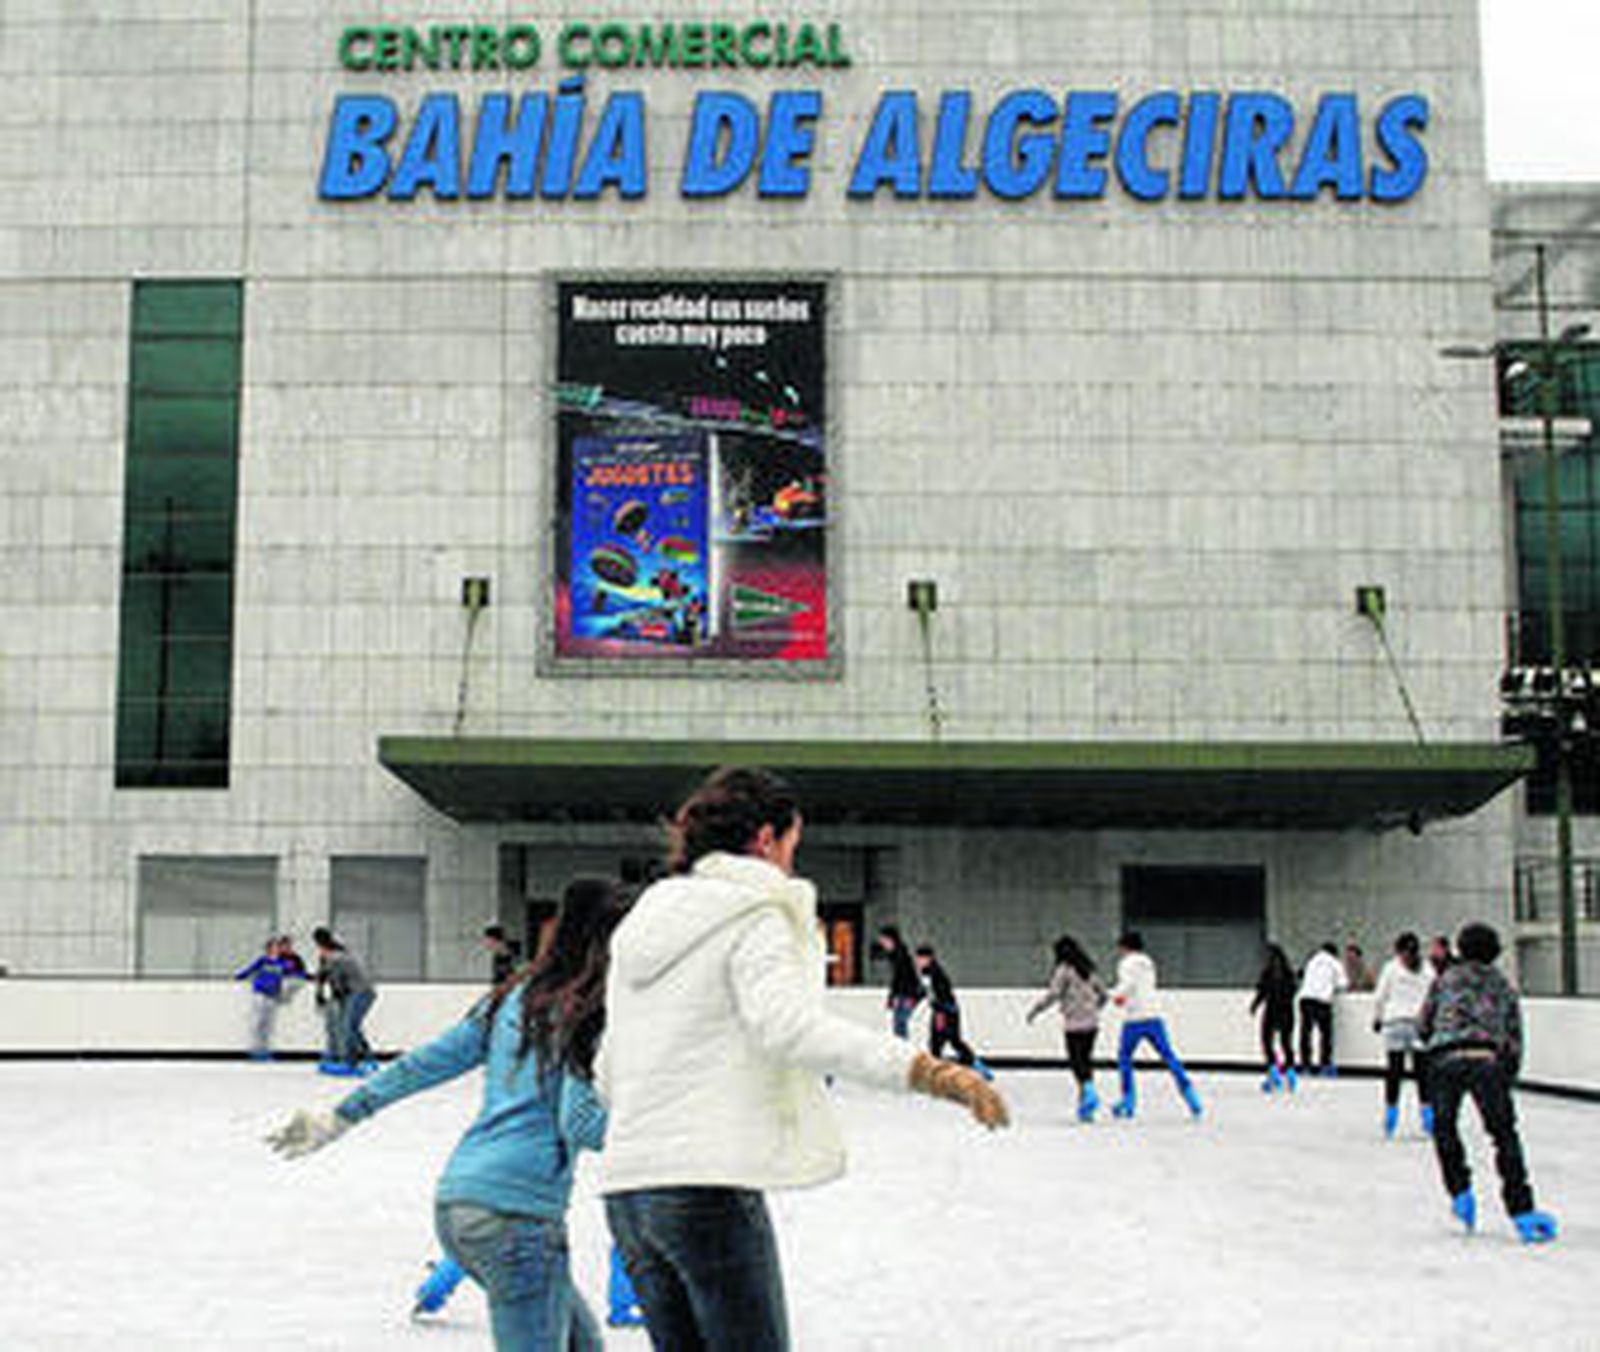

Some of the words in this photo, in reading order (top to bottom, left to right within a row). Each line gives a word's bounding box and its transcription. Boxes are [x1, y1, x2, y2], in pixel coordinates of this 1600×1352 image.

[338, 25, 541, 71] CENTRO
[557, 23, 851, 69] COMERCIAL
[318, 75, 648, 201] BAHÍA
[681, 90, 824, 200] DE
[845, 89, 1430, 204] ALGECIRAS
[630, 293, 709, 321] realidad
[614, 323, 678, 346] cuesta
[720, 325, 767, 348] poco
